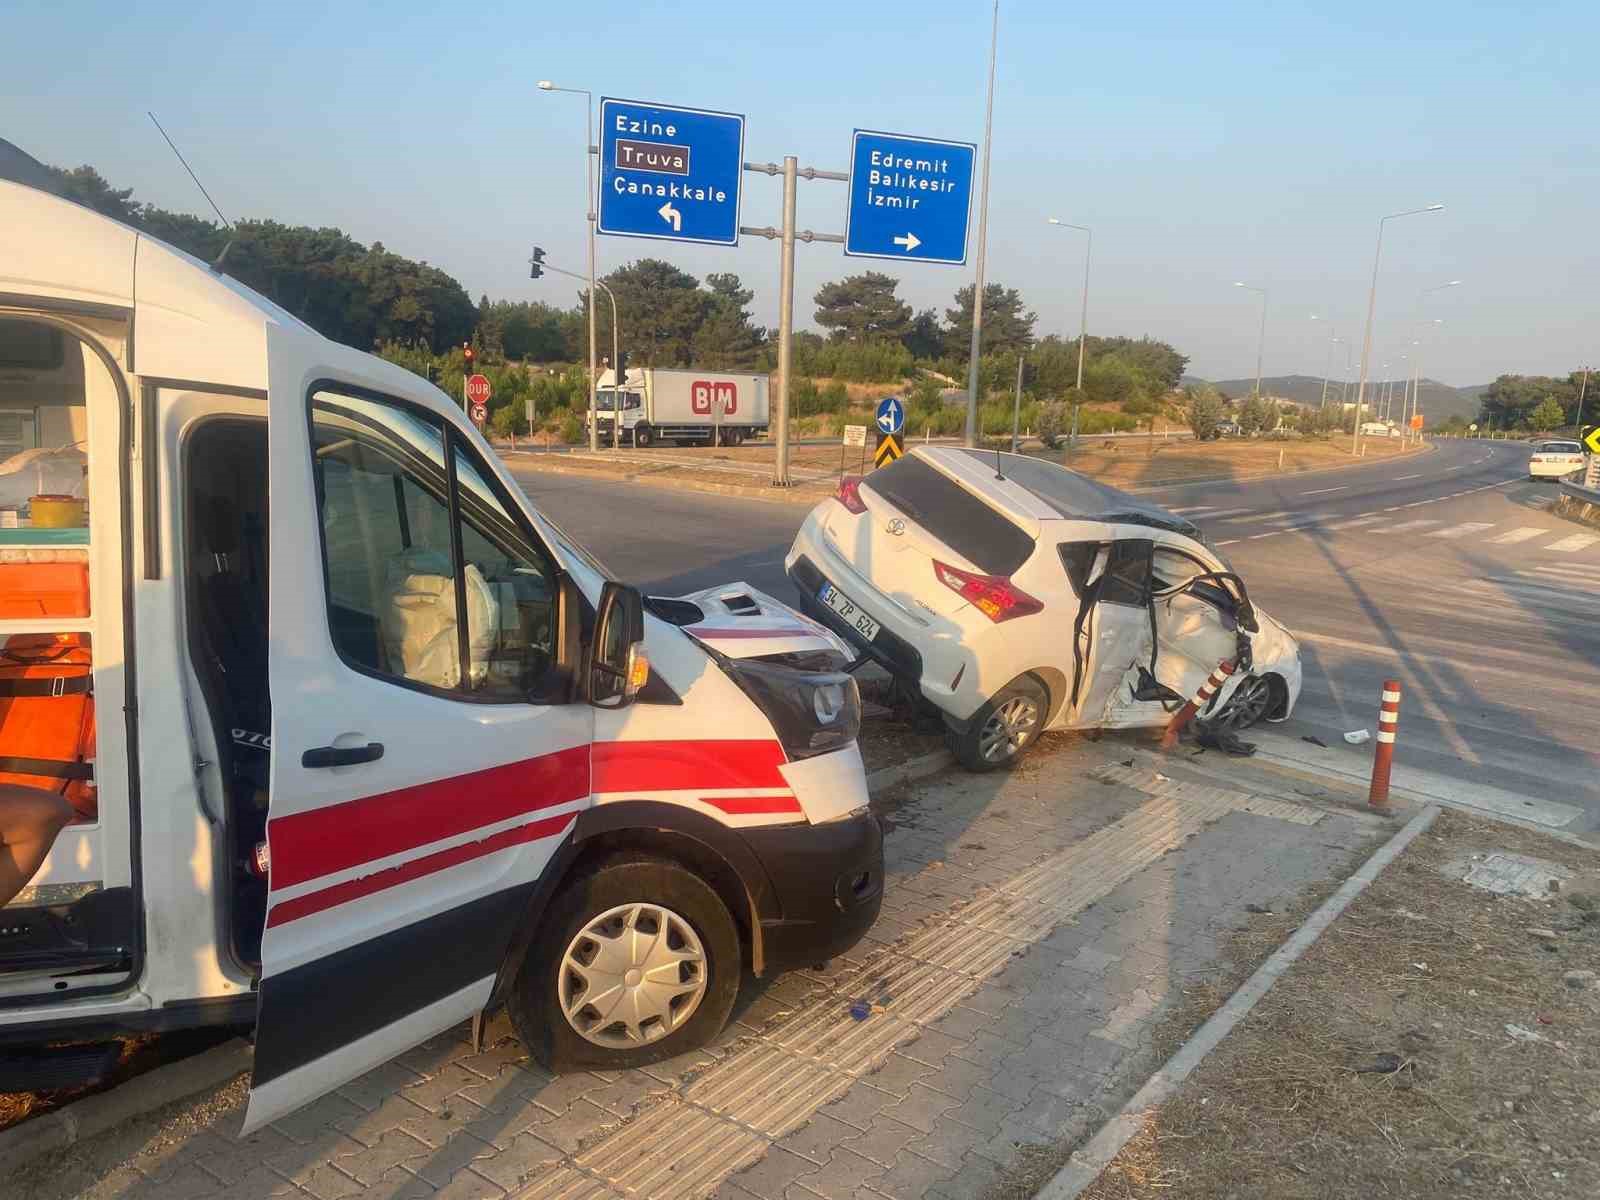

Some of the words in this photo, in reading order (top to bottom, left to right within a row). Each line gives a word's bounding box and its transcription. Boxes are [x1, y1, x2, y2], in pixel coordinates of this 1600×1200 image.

[616, 115, 676, 136] Ezine
[622, 146, 684, 168] Truva
[871, 151, 949, 173] Edremit
[614, 176, 727, 202] Çanakkale
[869, 170, 956, 193] Balıkesir
[470, 383, 489, 395] DUR
[824, 588, 838, 605] 34
[839, 600, 854, 617] ZP
[856, 615, 875, 637] 624
